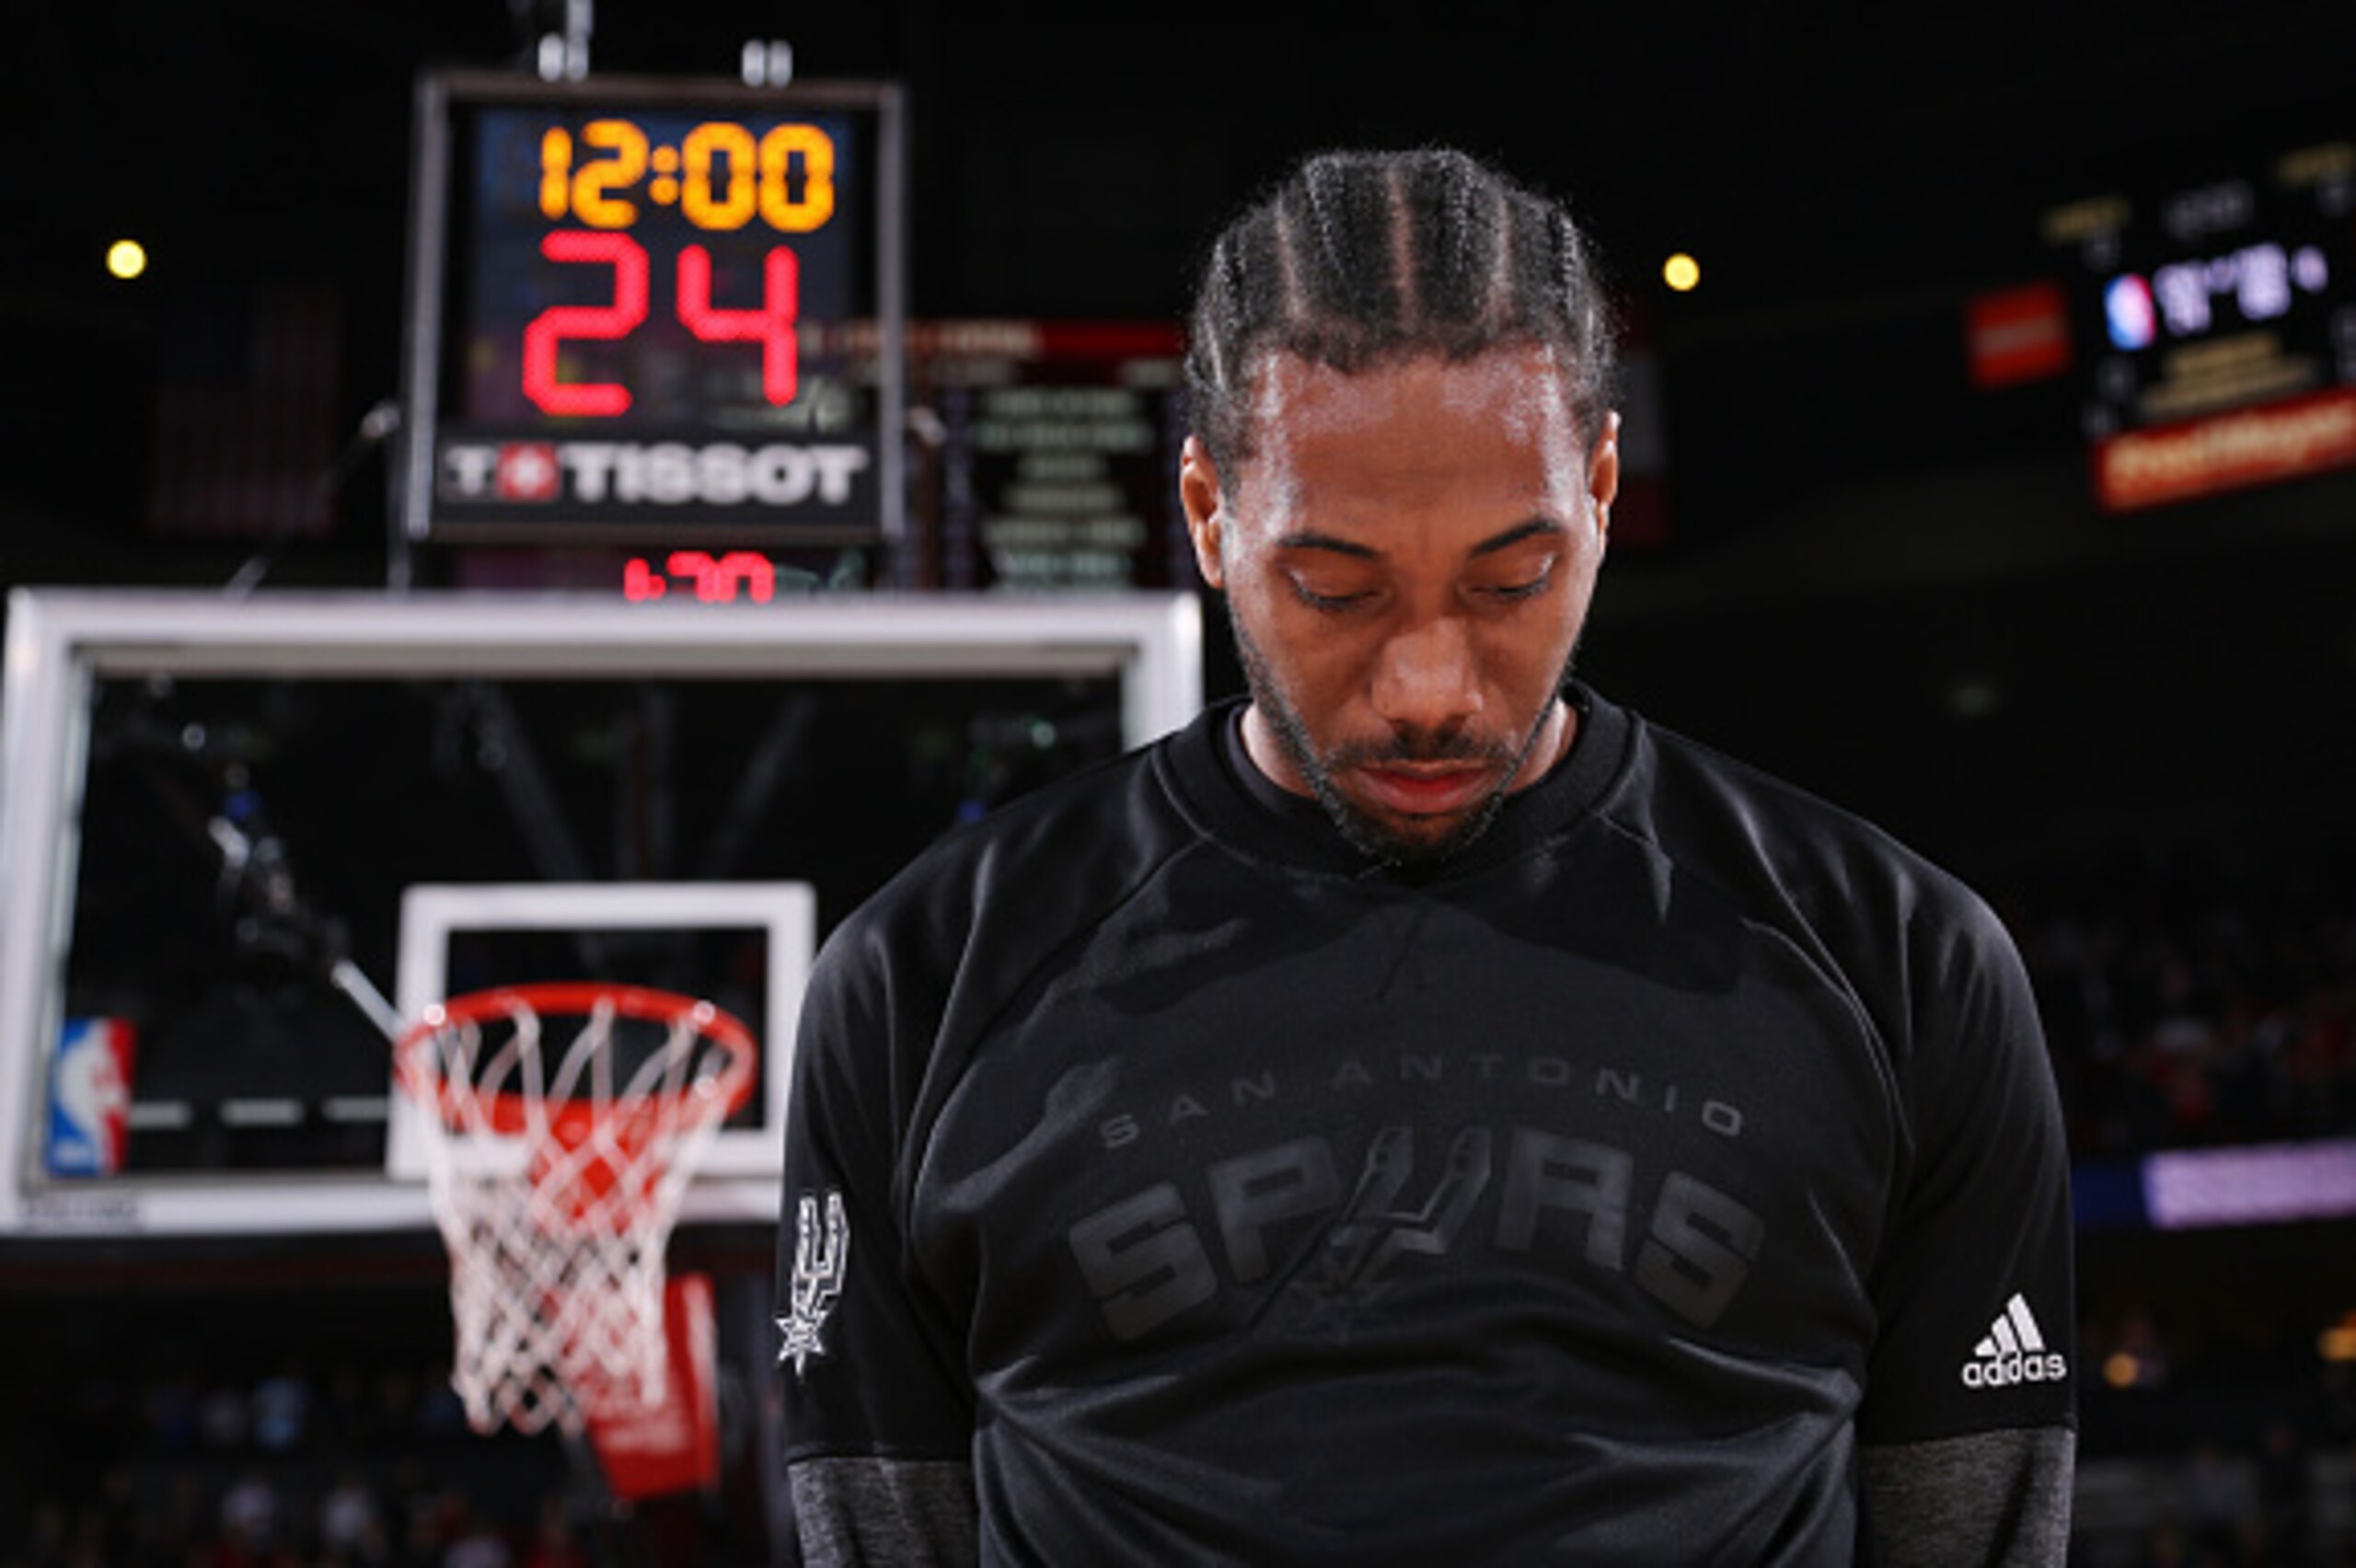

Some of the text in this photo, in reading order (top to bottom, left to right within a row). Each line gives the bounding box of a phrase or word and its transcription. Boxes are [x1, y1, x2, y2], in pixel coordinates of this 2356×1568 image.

[538, 119, 835, 233] 12:00
[522, 230, 799, 417] 24
[562, 441, 871, 503] TISSOT
[1100, 1053, 1744, 1150] SAN ANTONIO
[1068, 1124, 1766, 1340] SPURS
[1961, 1349, 2067, 1388] adidas
